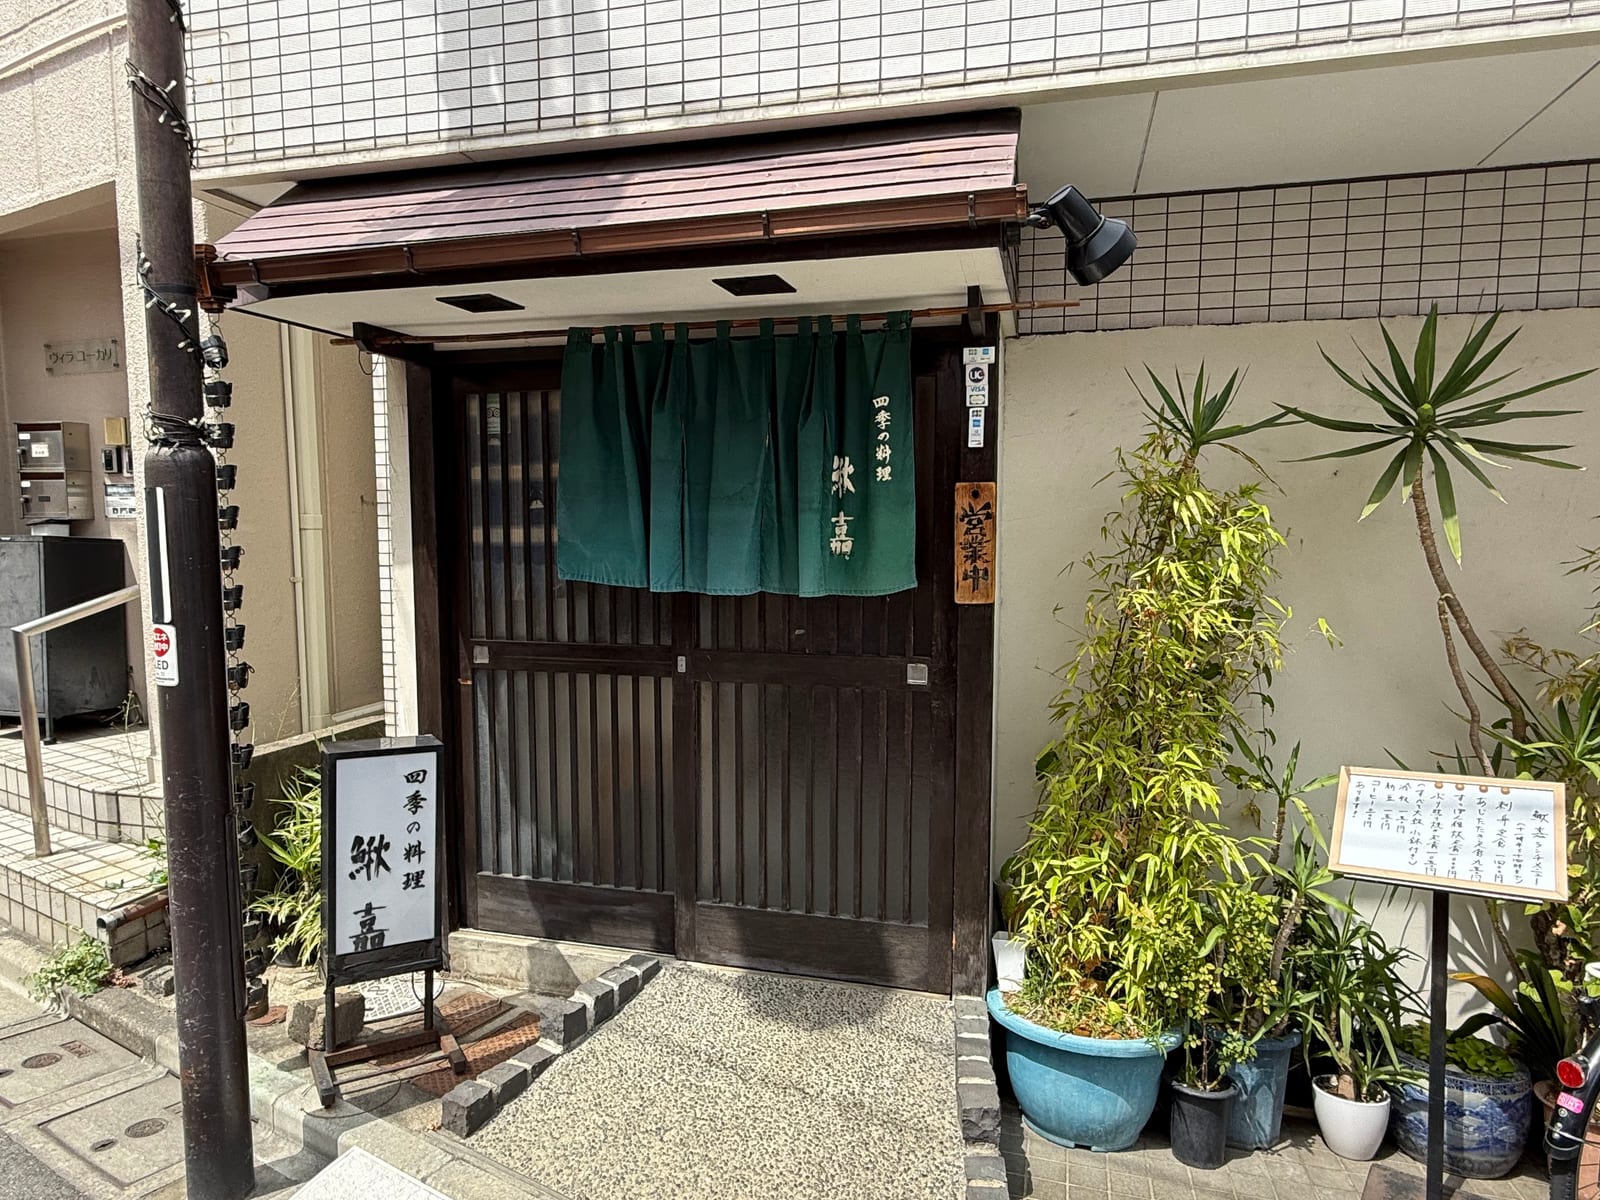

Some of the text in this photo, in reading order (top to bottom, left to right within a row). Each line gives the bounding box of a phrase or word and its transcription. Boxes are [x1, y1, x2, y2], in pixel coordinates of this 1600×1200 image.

[872, 395, 892, 483] 四季の料理
[960, 502, 993, 593] 営業中
[402, 768, 428, 890] 四季の料理
[348, 834, 392, 953] 鰍嘉
